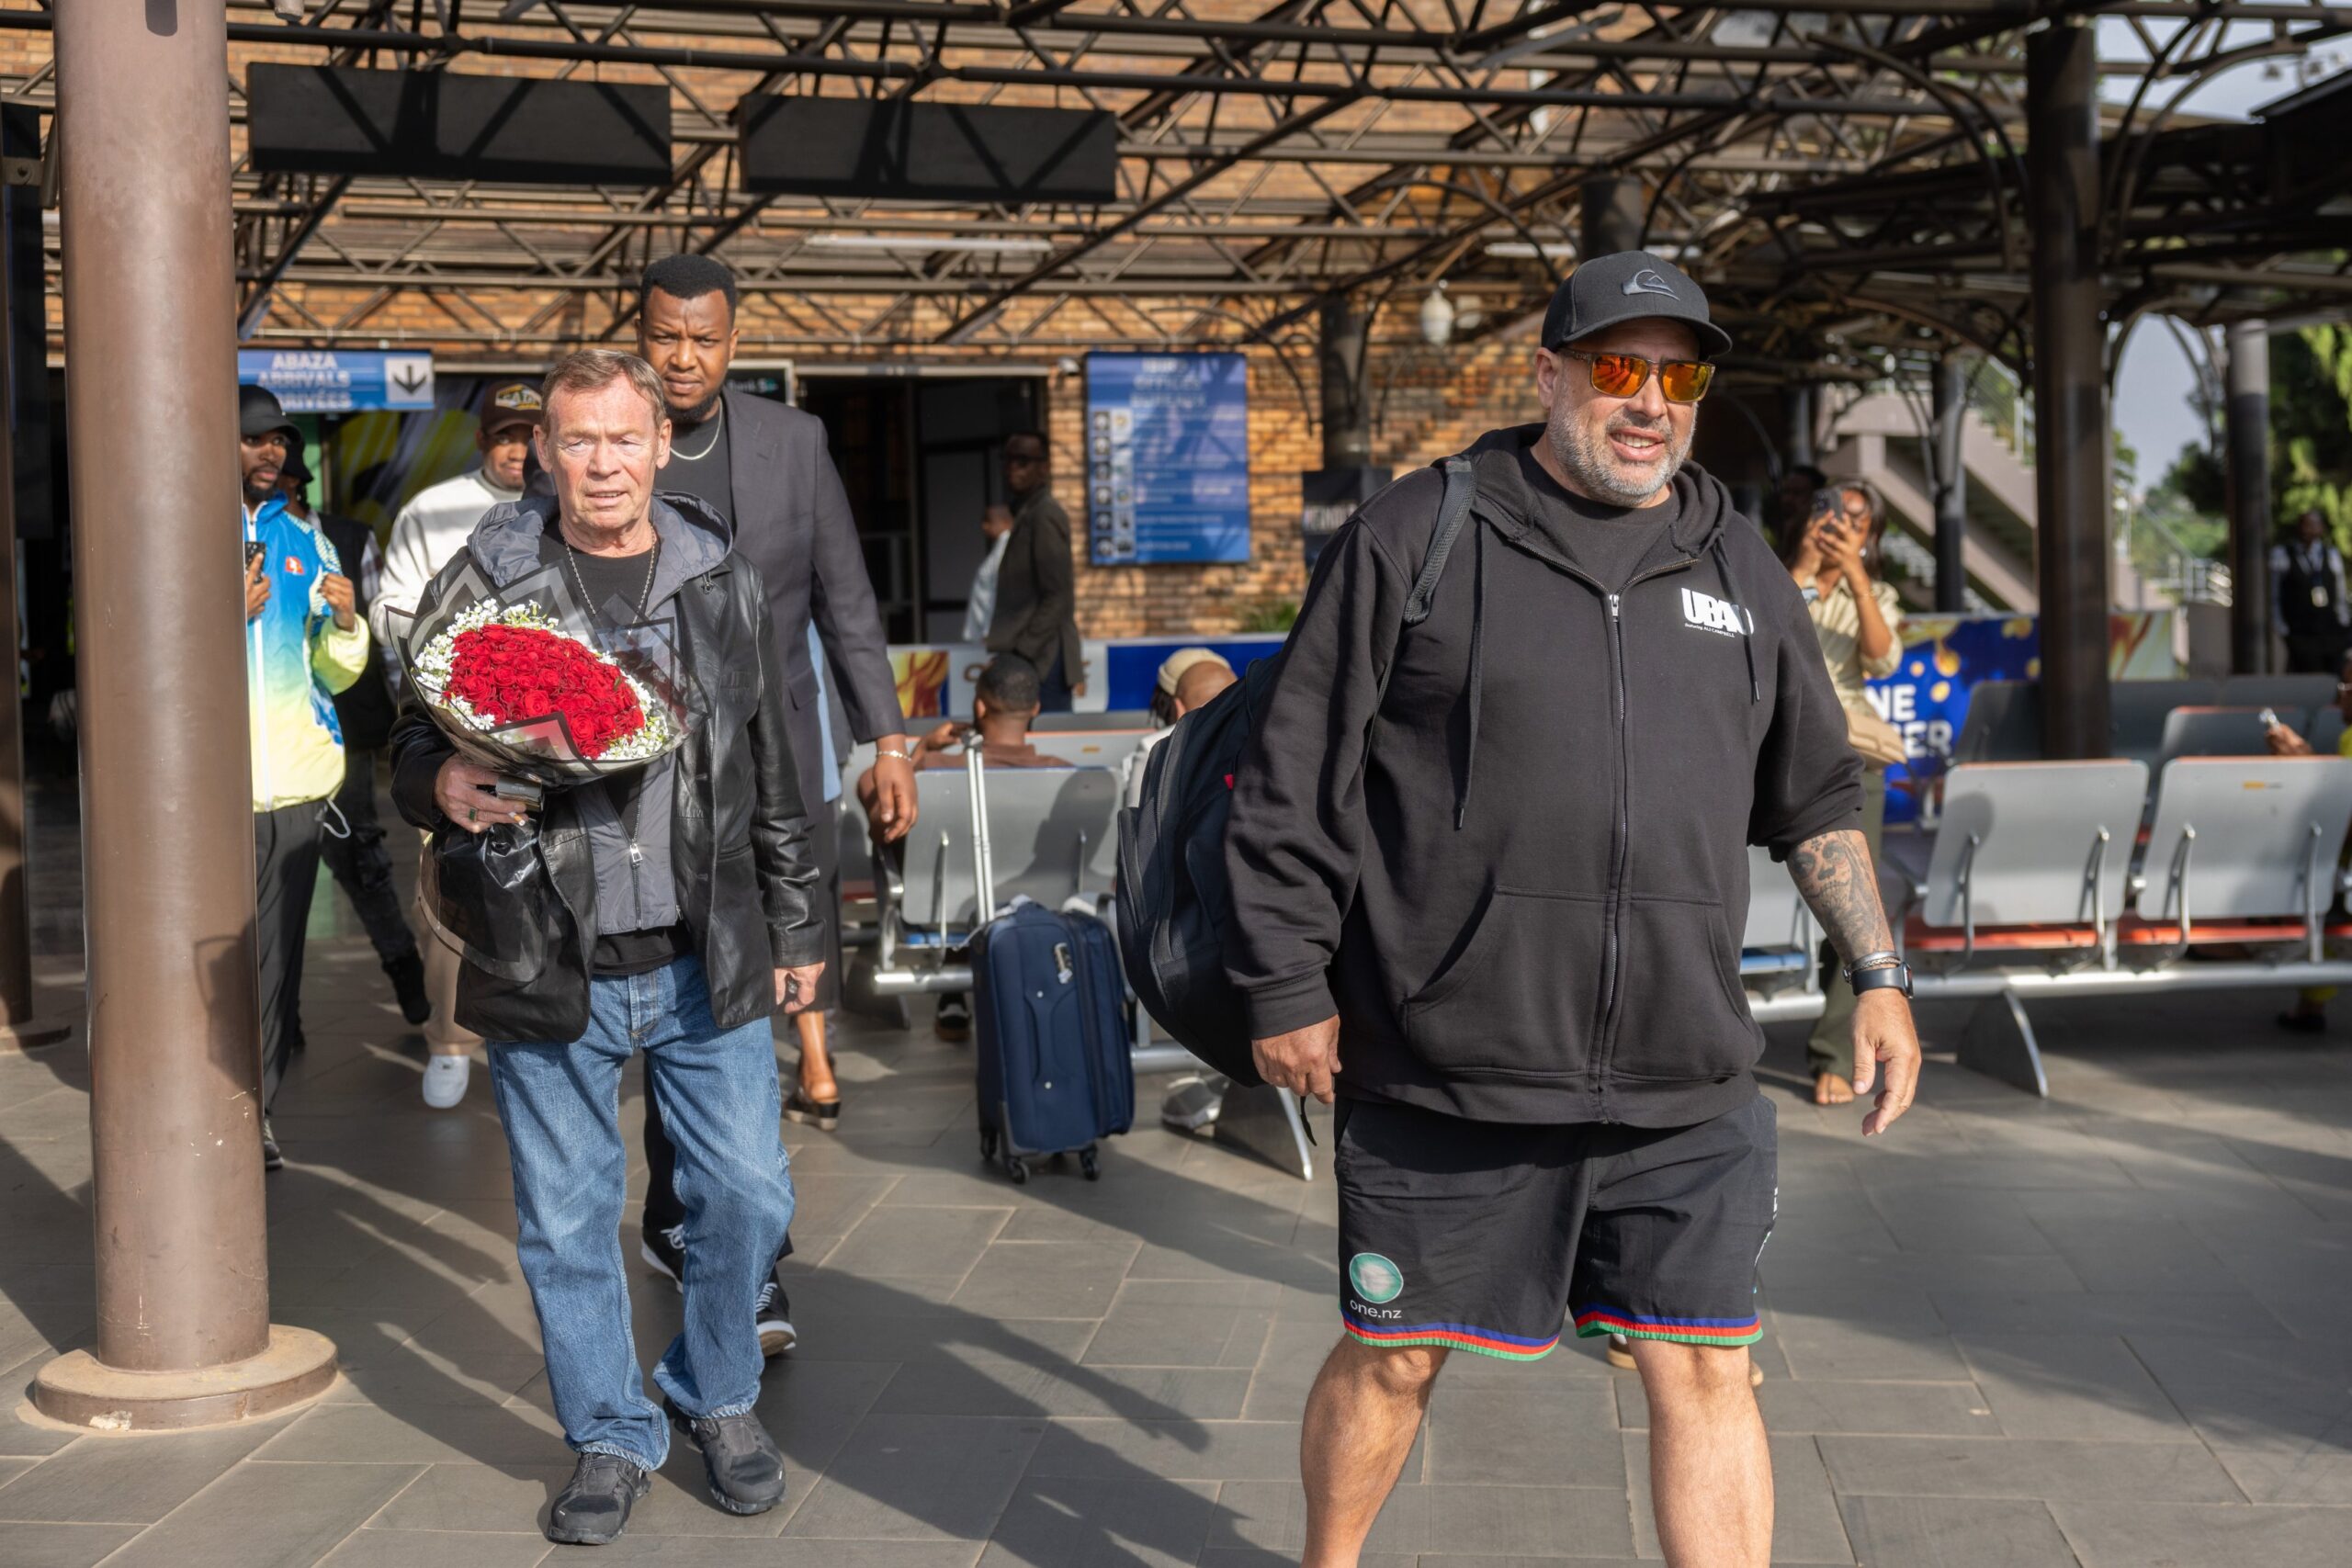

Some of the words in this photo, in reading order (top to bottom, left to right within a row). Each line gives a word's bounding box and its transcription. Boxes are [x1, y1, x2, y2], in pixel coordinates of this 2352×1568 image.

[272, 353, 337, 369] ABAZA
[1864, 683, 1917, 722] NE
[1892, 720, 1952, 758] ER
[1351, 1300, 1402, 1319] one.nz
